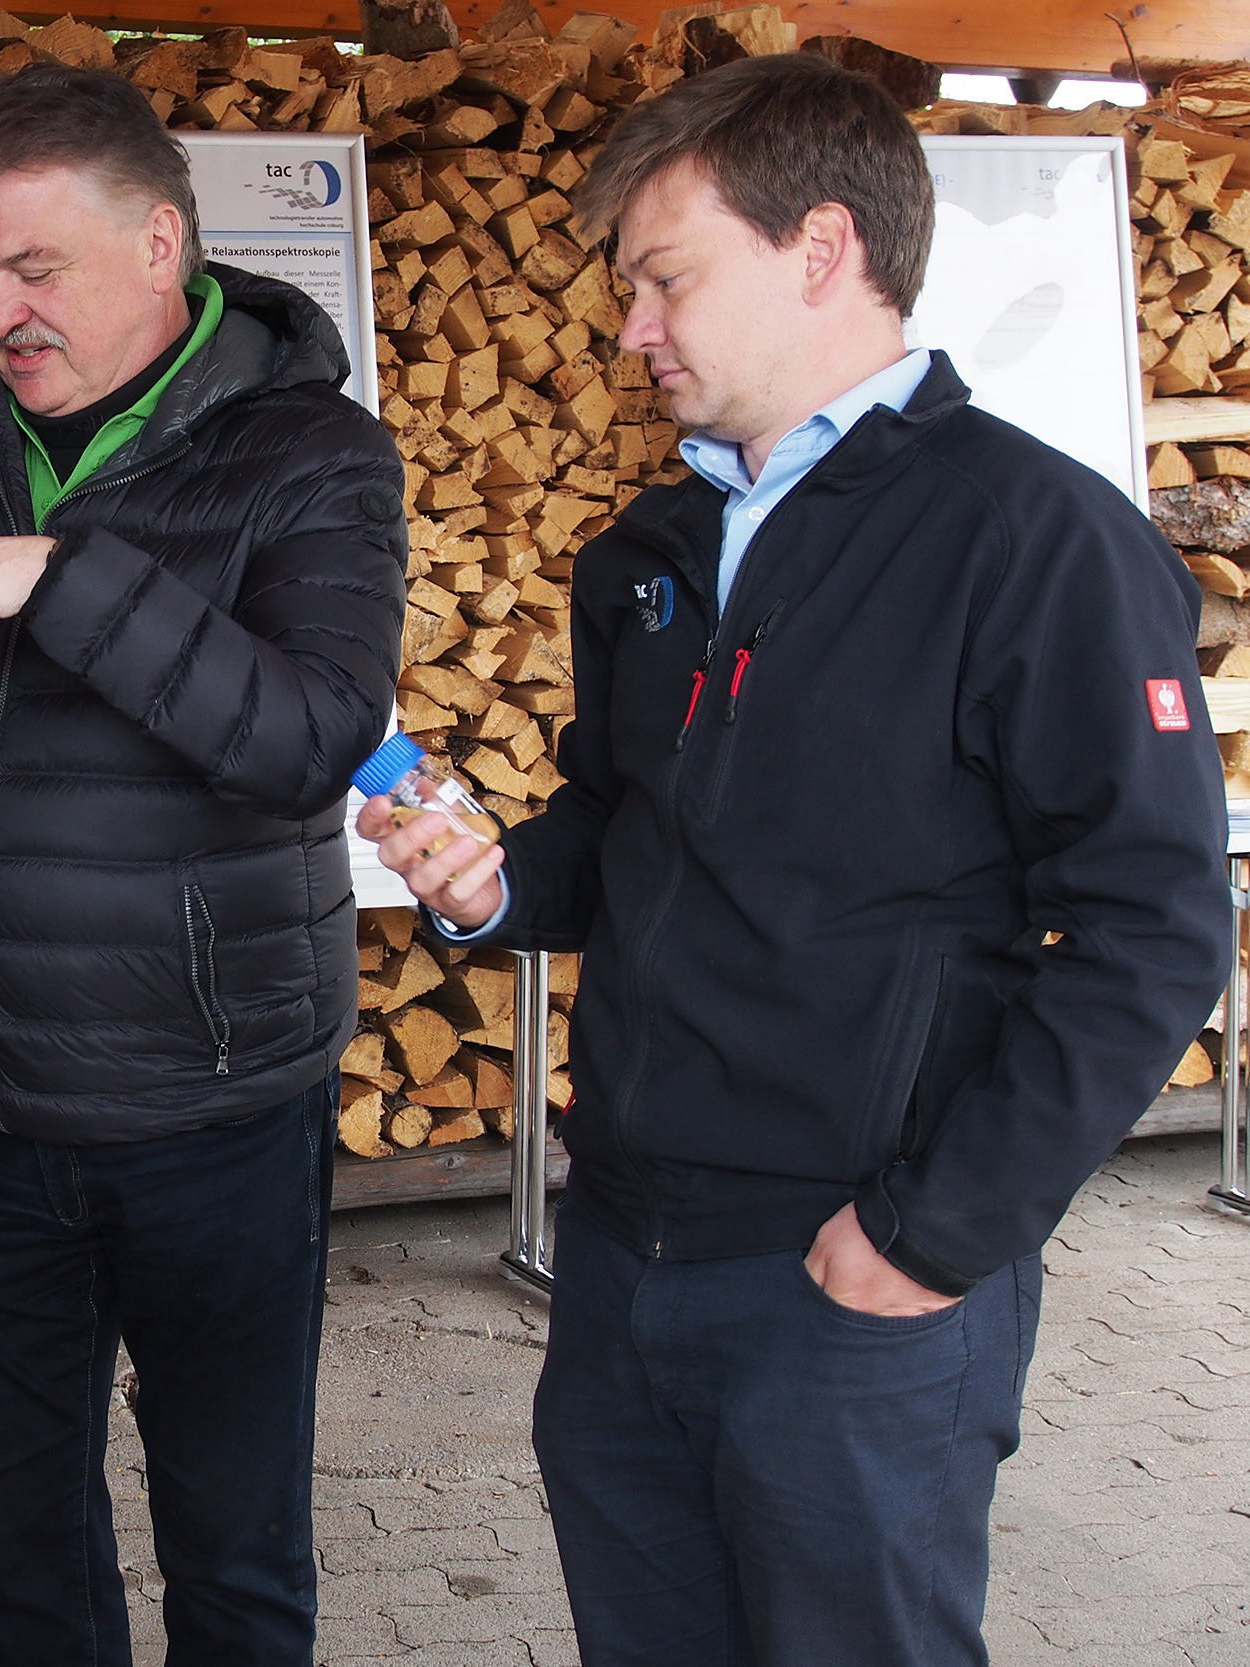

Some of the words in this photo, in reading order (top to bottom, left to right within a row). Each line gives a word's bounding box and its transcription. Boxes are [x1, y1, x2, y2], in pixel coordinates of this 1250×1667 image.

[266, 163, 292, 178] tac
[211, 247, 341, 258] Relaxationsspektroskopie
[256, 269, 280, 277] Aufbau
